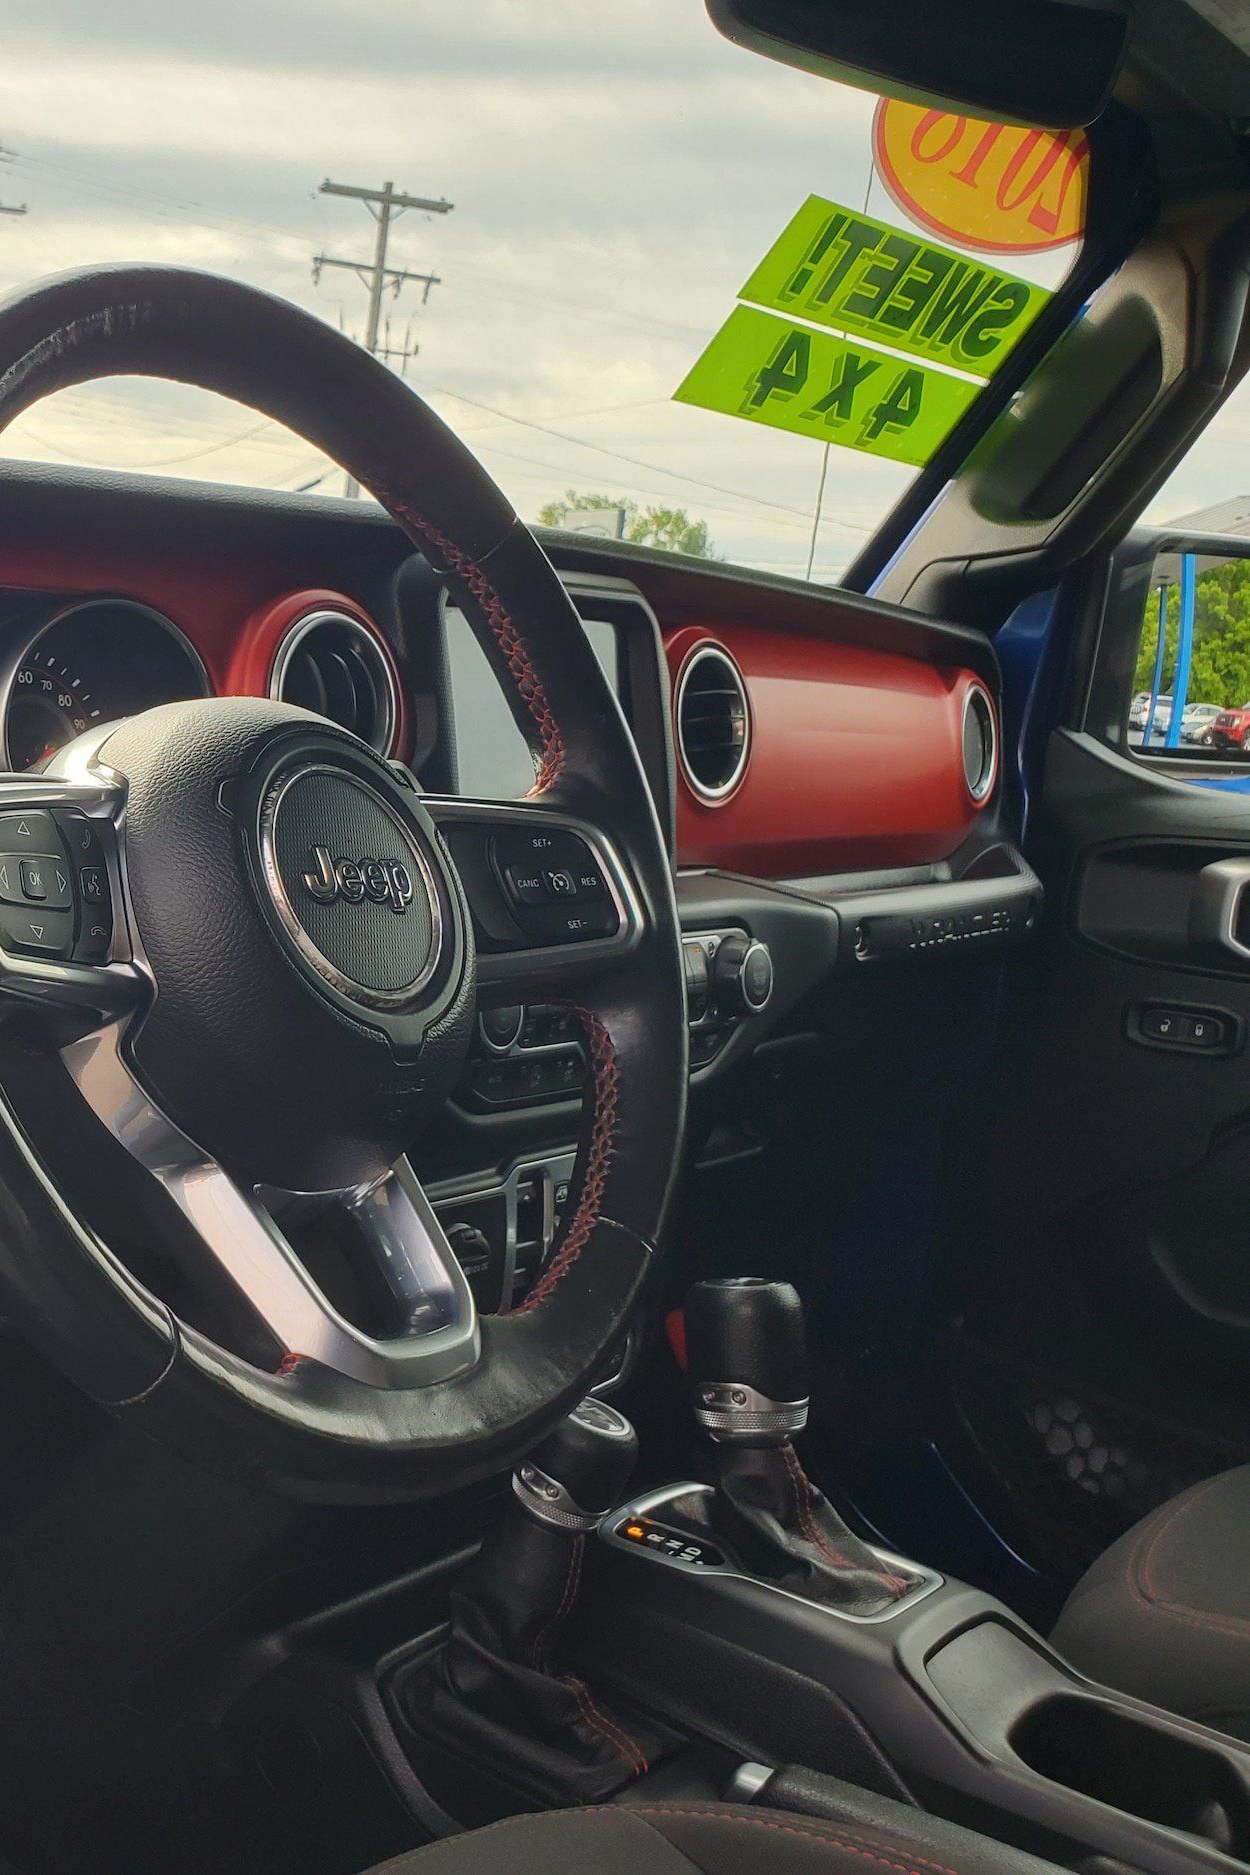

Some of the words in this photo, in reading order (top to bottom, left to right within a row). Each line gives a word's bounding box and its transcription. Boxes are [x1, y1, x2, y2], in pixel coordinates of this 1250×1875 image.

[18, 671, 33, 684] 60
[41, 680, 53, 690] 70
[58, 694, 72, 707] 80
[74, 719, 85, 729] 90
[532, 838, 552, 848] SET+
[29, 871, 42, 885] OK
[303, 844, 413, 914] Jeep
[581, 877, 597, 886] RES
[517, 879, 540, 888] CANC
